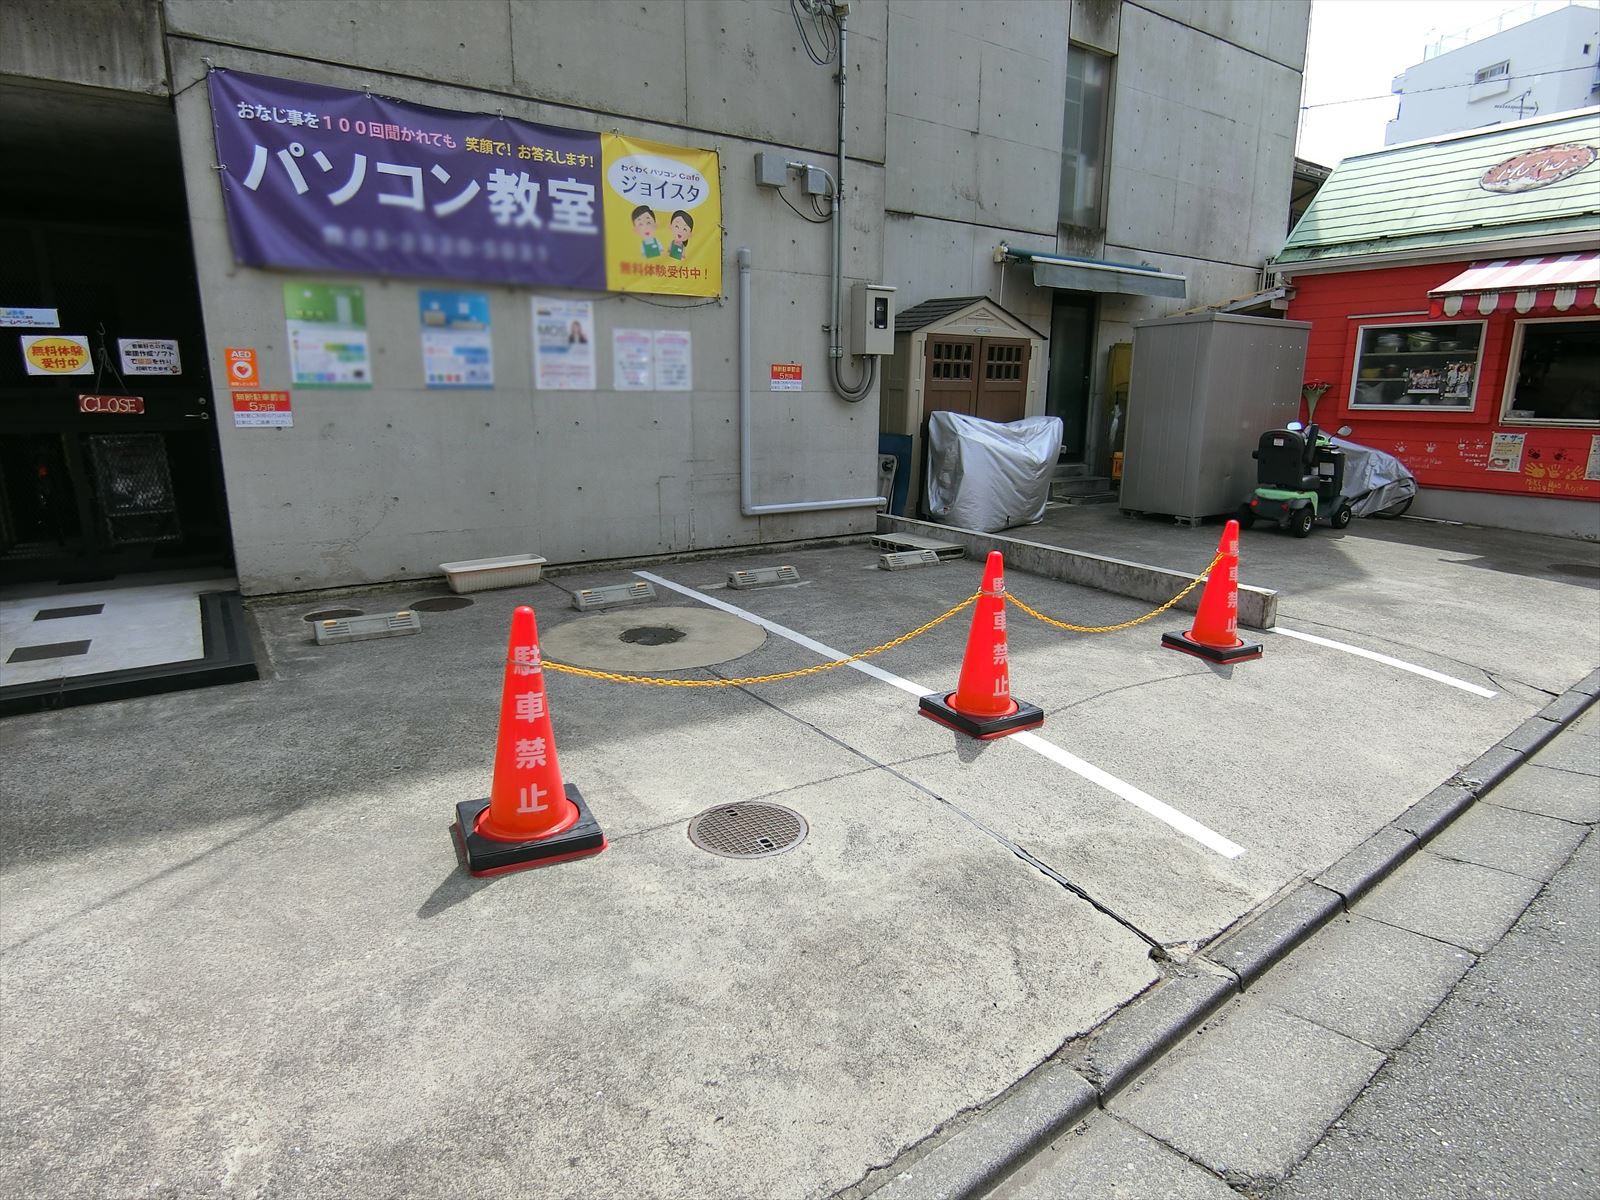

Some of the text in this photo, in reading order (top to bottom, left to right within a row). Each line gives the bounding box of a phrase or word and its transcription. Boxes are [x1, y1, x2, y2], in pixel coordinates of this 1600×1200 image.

[621, 164, 648, 174] わくわく
[243, 142, 598, 235] パソコン教室
[621, 176, 700, 203] ジョイスタ
[31, 345, 84, 357] 無料体験
[42, 358, 79, 368] 受付中
[83, 397, 137, 412] CLOSE
[513, 644, 549, 814] 駐車禁止
